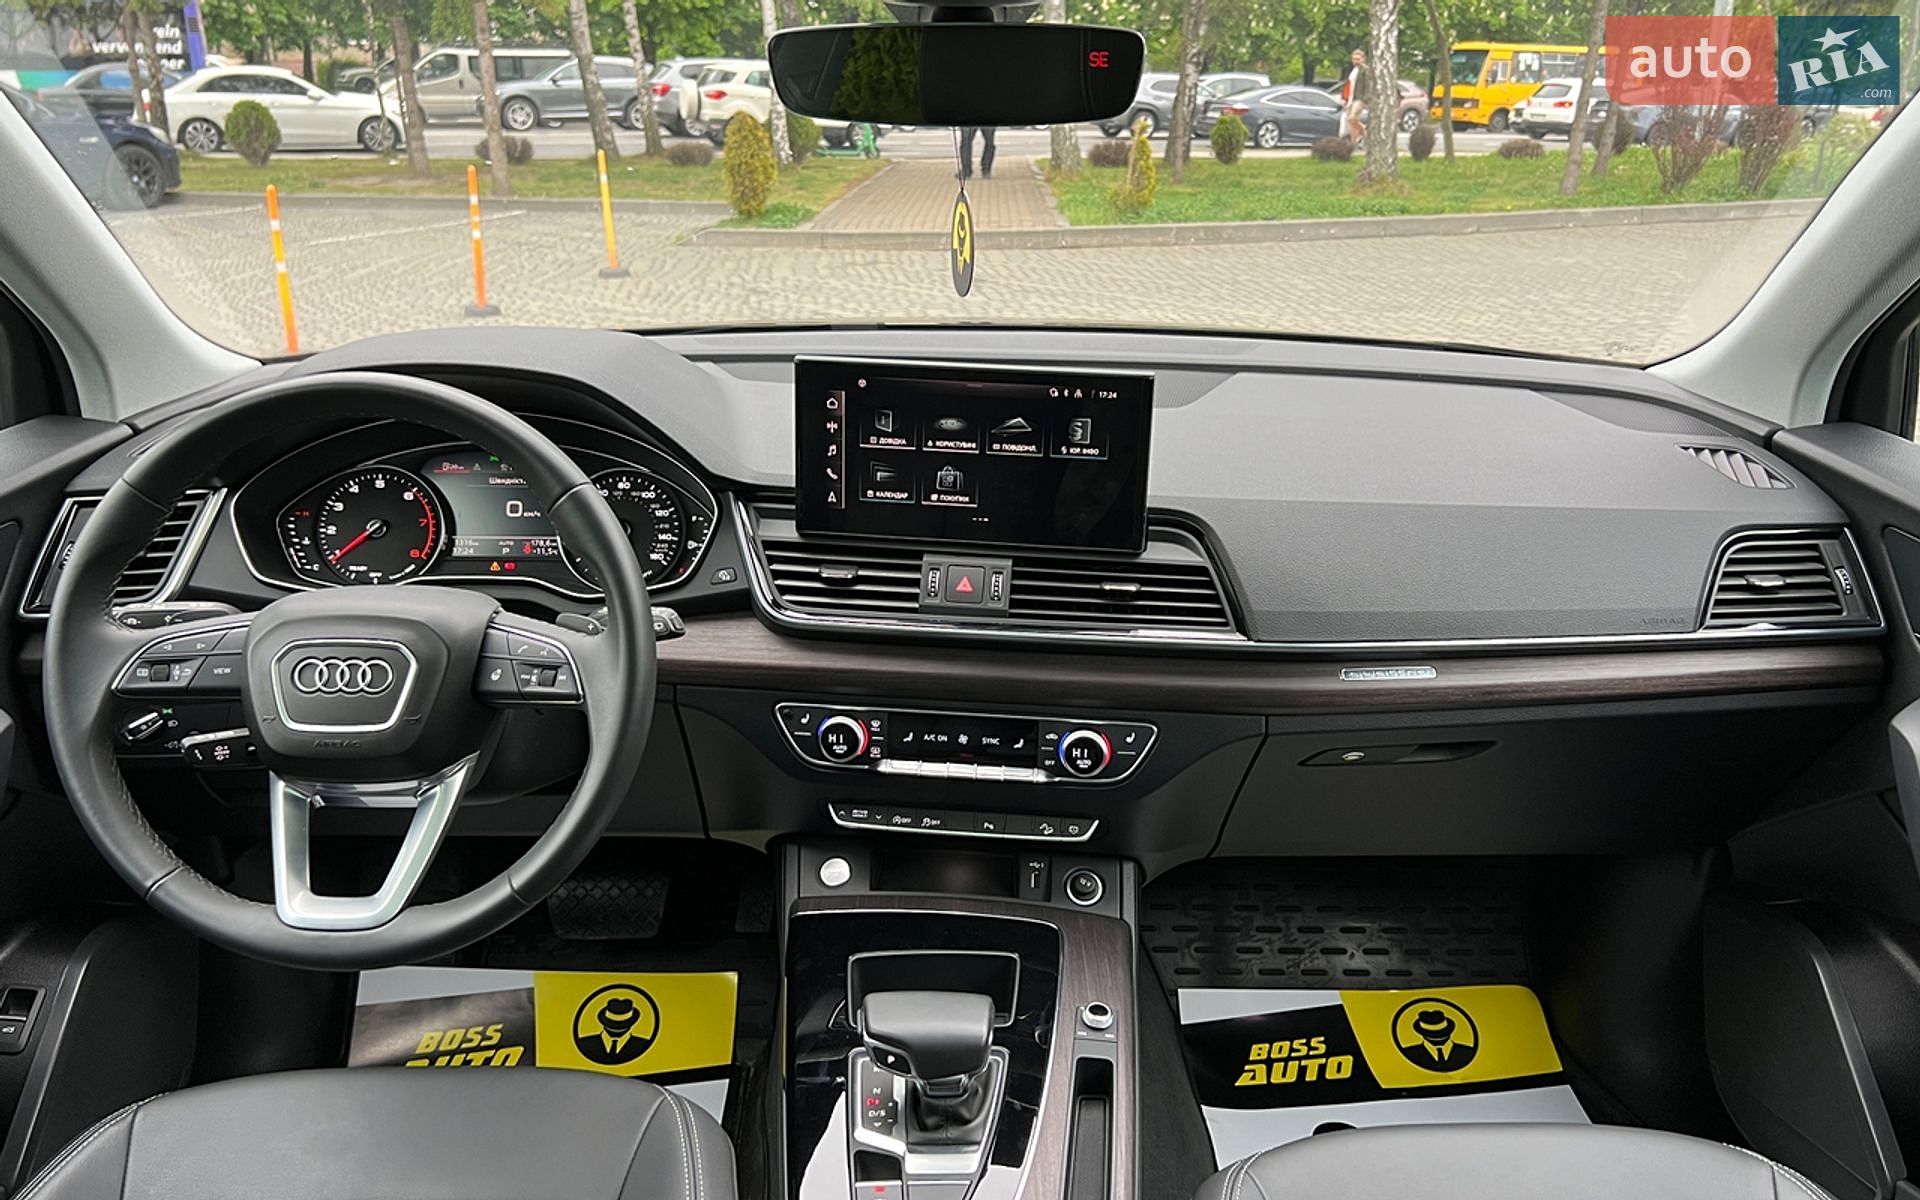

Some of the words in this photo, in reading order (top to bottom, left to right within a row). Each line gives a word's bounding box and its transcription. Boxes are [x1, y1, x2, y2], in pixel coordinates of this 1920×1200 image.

[1088, 51, 1110, 68] SE
[1099, 391, 1117, 399] 17:24
[374, 479, 386, 489] 5
[617, 481, 631, 490] 80
[348, 484, 360, 494] 4
[403, 491, 415, 501] 6
[641, 491, 656, 499] 100
[333, 502, 344, 512] 3
[506, 500, 523, 518] 0
[655, 509, 670, 517] 120
[418, 518, 428, 527] 7
[326, 525, 338, 535] 2
[658, 533, 672, 541] 140
[410, 549, 420, 558] 8
[502, 547, 510, 555] P
[213, 667, 232, 675] VIEW
[982, 736, 1000, 746] SYNC
[1044, 759, 1056, 767] OFF
[415, 1023, 504, 1054] BOSS
[1249, 1036, 1327, 1060] BOSS
[405, 1046, 525, 1067] TO
[887, 1055, 896, 1064] P
[1234, 1055, 1354, 1086] AUTO
[872, 1087, 882, 1095] N
